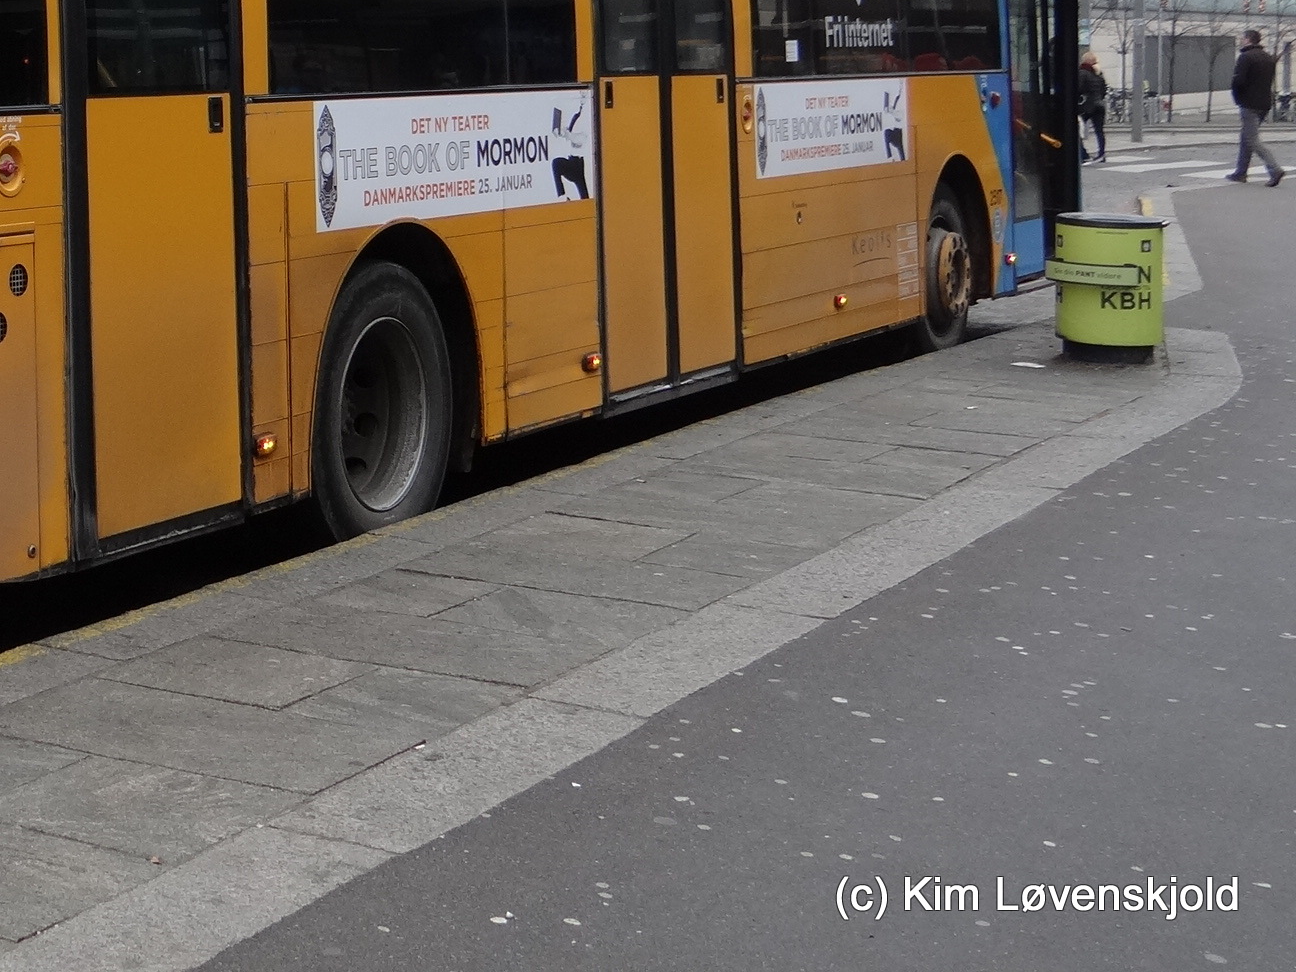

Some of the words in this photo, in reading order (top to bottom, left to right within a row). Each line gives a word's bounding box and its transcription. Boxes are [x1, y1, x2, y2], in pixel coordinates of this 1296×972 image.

[825, 15, 842, 48] Fri
[845, 16, 894, 48] internet
[411, 117, 432, 135] DET
[435, 117, 448, 132] NY
[452, 114, 489, 131] TEATER
[768, 119, 790, 143] THE
[792, 116, 823, 141] BOOK
[841, 112, 883, 135] MORMON
[339, 147, 378, 180] THE
[385, 142, 440, 177] BOOK
[445, 140, 470, 171] OF
[476, 135, 549, 167] MORMON
[363, 179, 475, 207] DANMARKSPREMIERE
[478, 178, 493, 194] 25.
[495, 174, 532, 193] JANUAR
[1100, 290, 1152, 310] KBH
